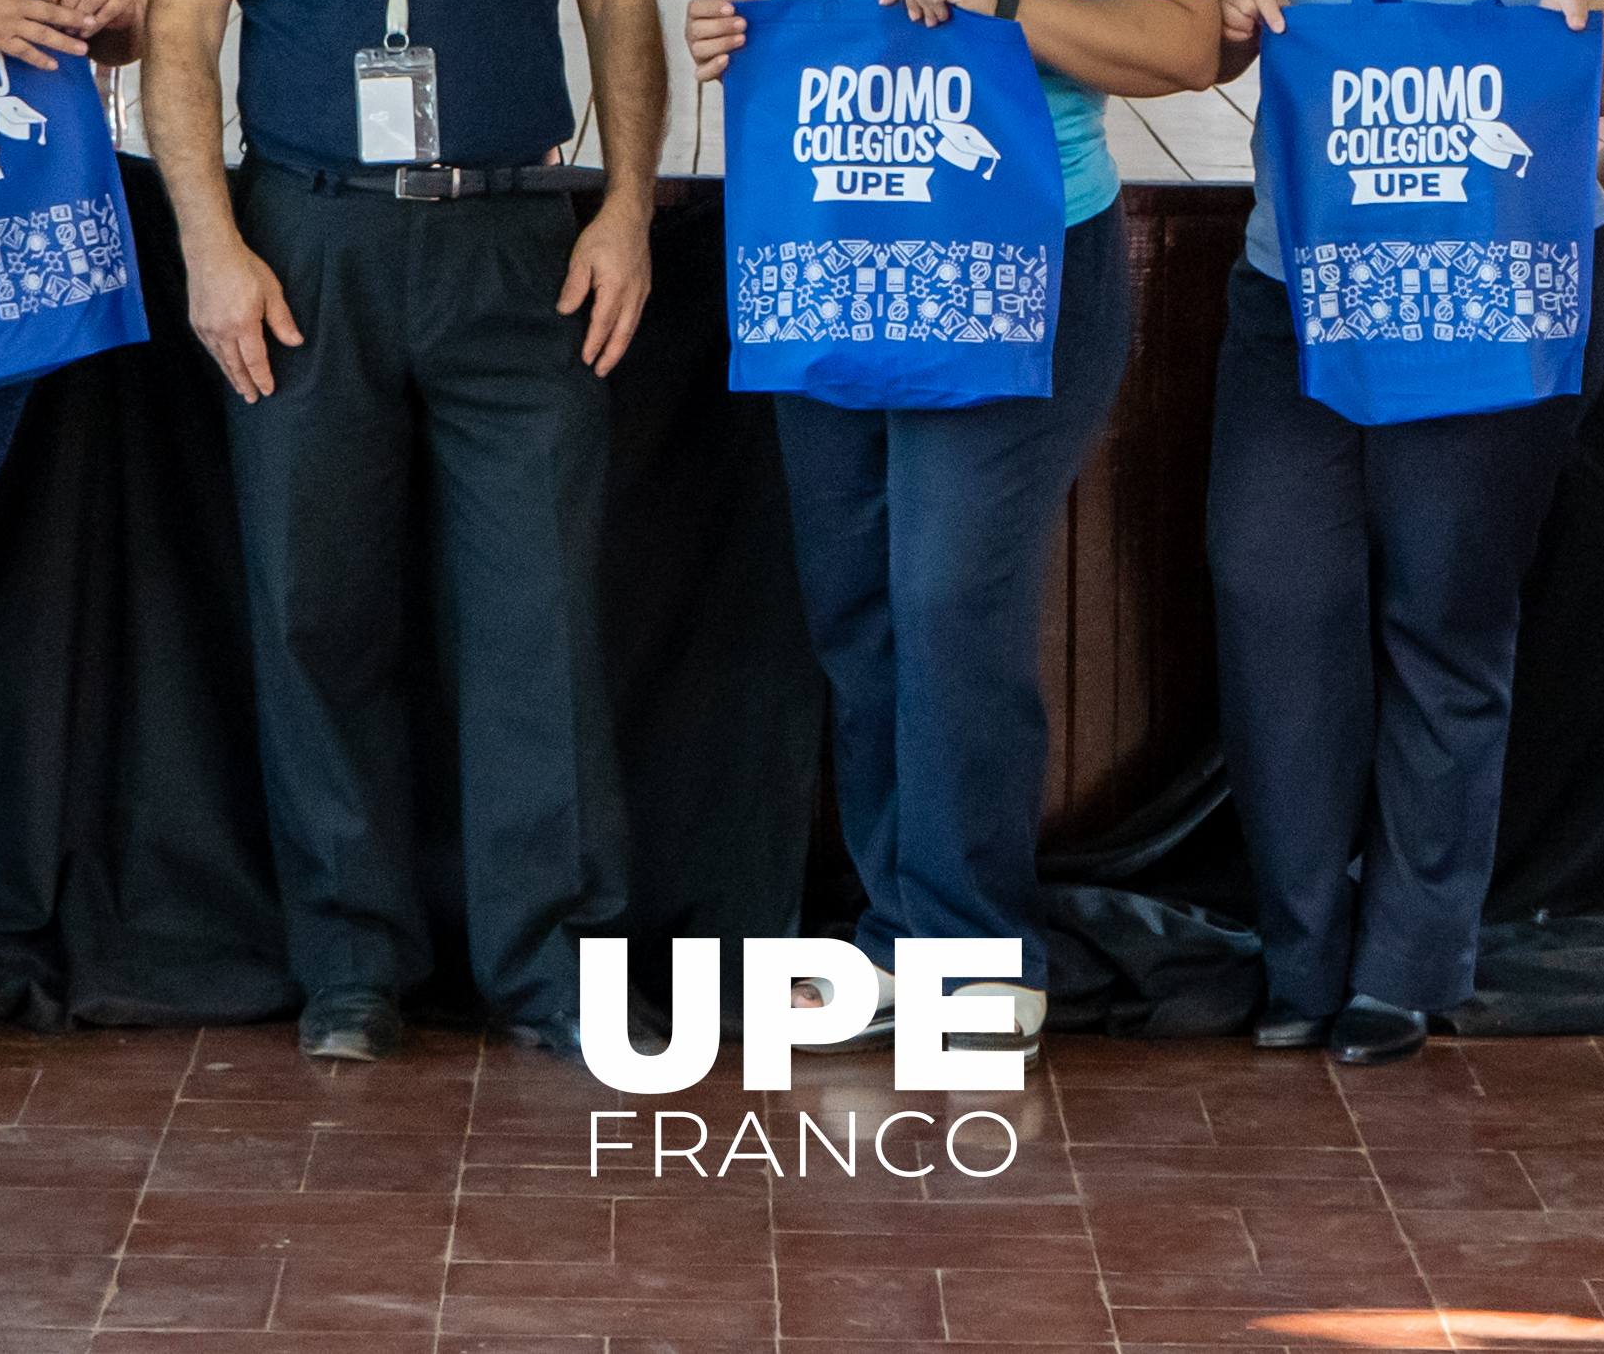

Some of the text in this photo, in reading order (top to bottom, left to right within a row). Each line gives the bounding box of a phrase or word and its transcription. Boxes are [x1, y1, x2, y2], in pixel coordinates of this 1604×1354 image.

[798, 64, 973, 125] PROMO
[1331, 63, 1503, 128] PROMO
[835, 170, 906, 197] UPE
[1373, 172, 1442, 198] UPE
